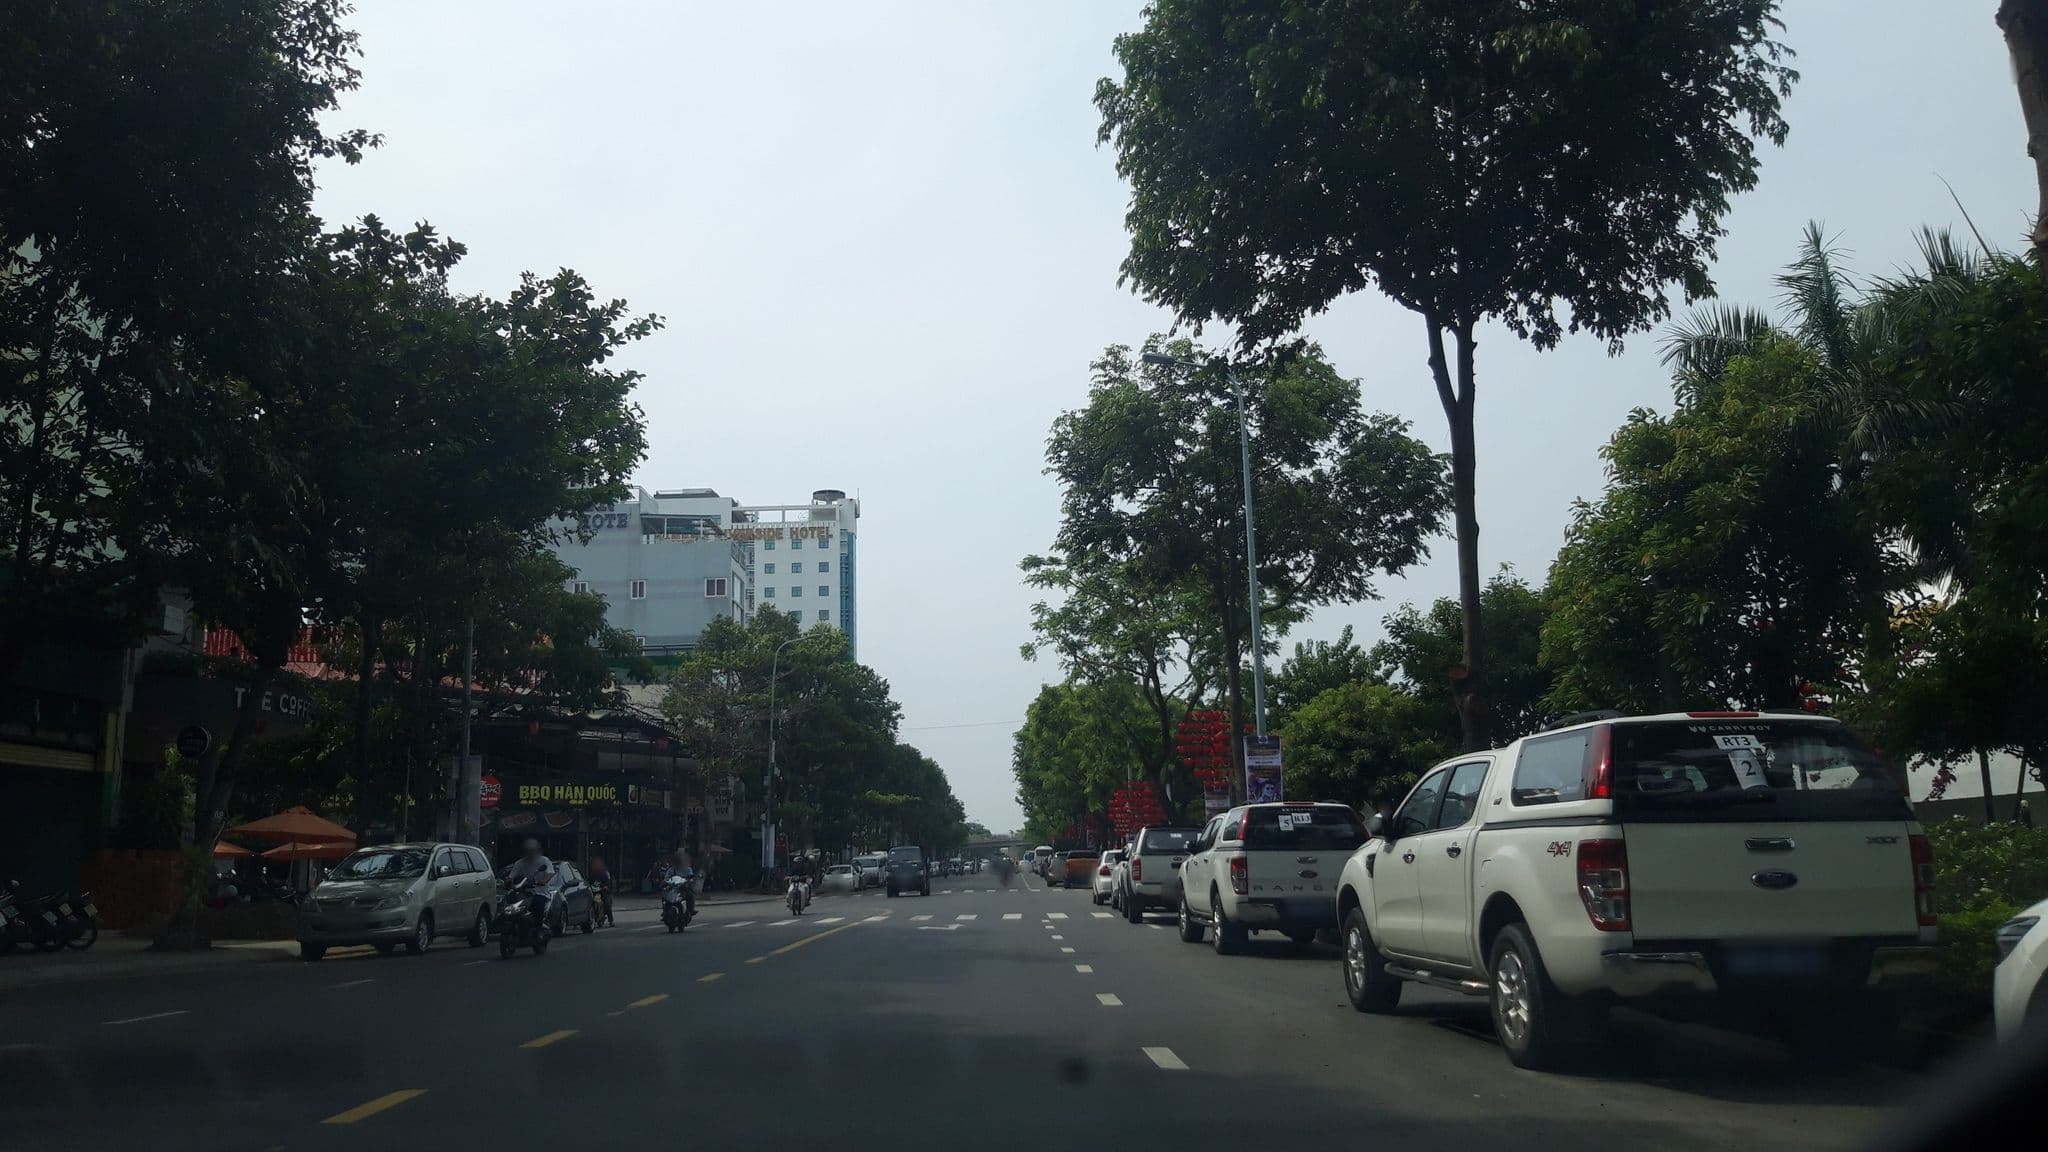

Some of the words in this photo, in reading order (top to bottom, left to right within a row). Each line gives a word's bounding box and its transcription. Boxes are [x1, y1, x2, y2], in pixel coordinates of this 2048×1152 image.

[789, 526, 834, 539] HOTEL
[233, 686, 273, 712] TE
[1708, 724, 1771, 732] CARRYBOY
[1722, 736, 1751, 746] RT3
[1741, 760, 1756, 777] 2
[519, 784, 551, 801] BBQ
[554, 782, 584, 800] HÀN
[587, 782, 616, 801] QUỐC
[1283, 819, 1290, 828] 5
